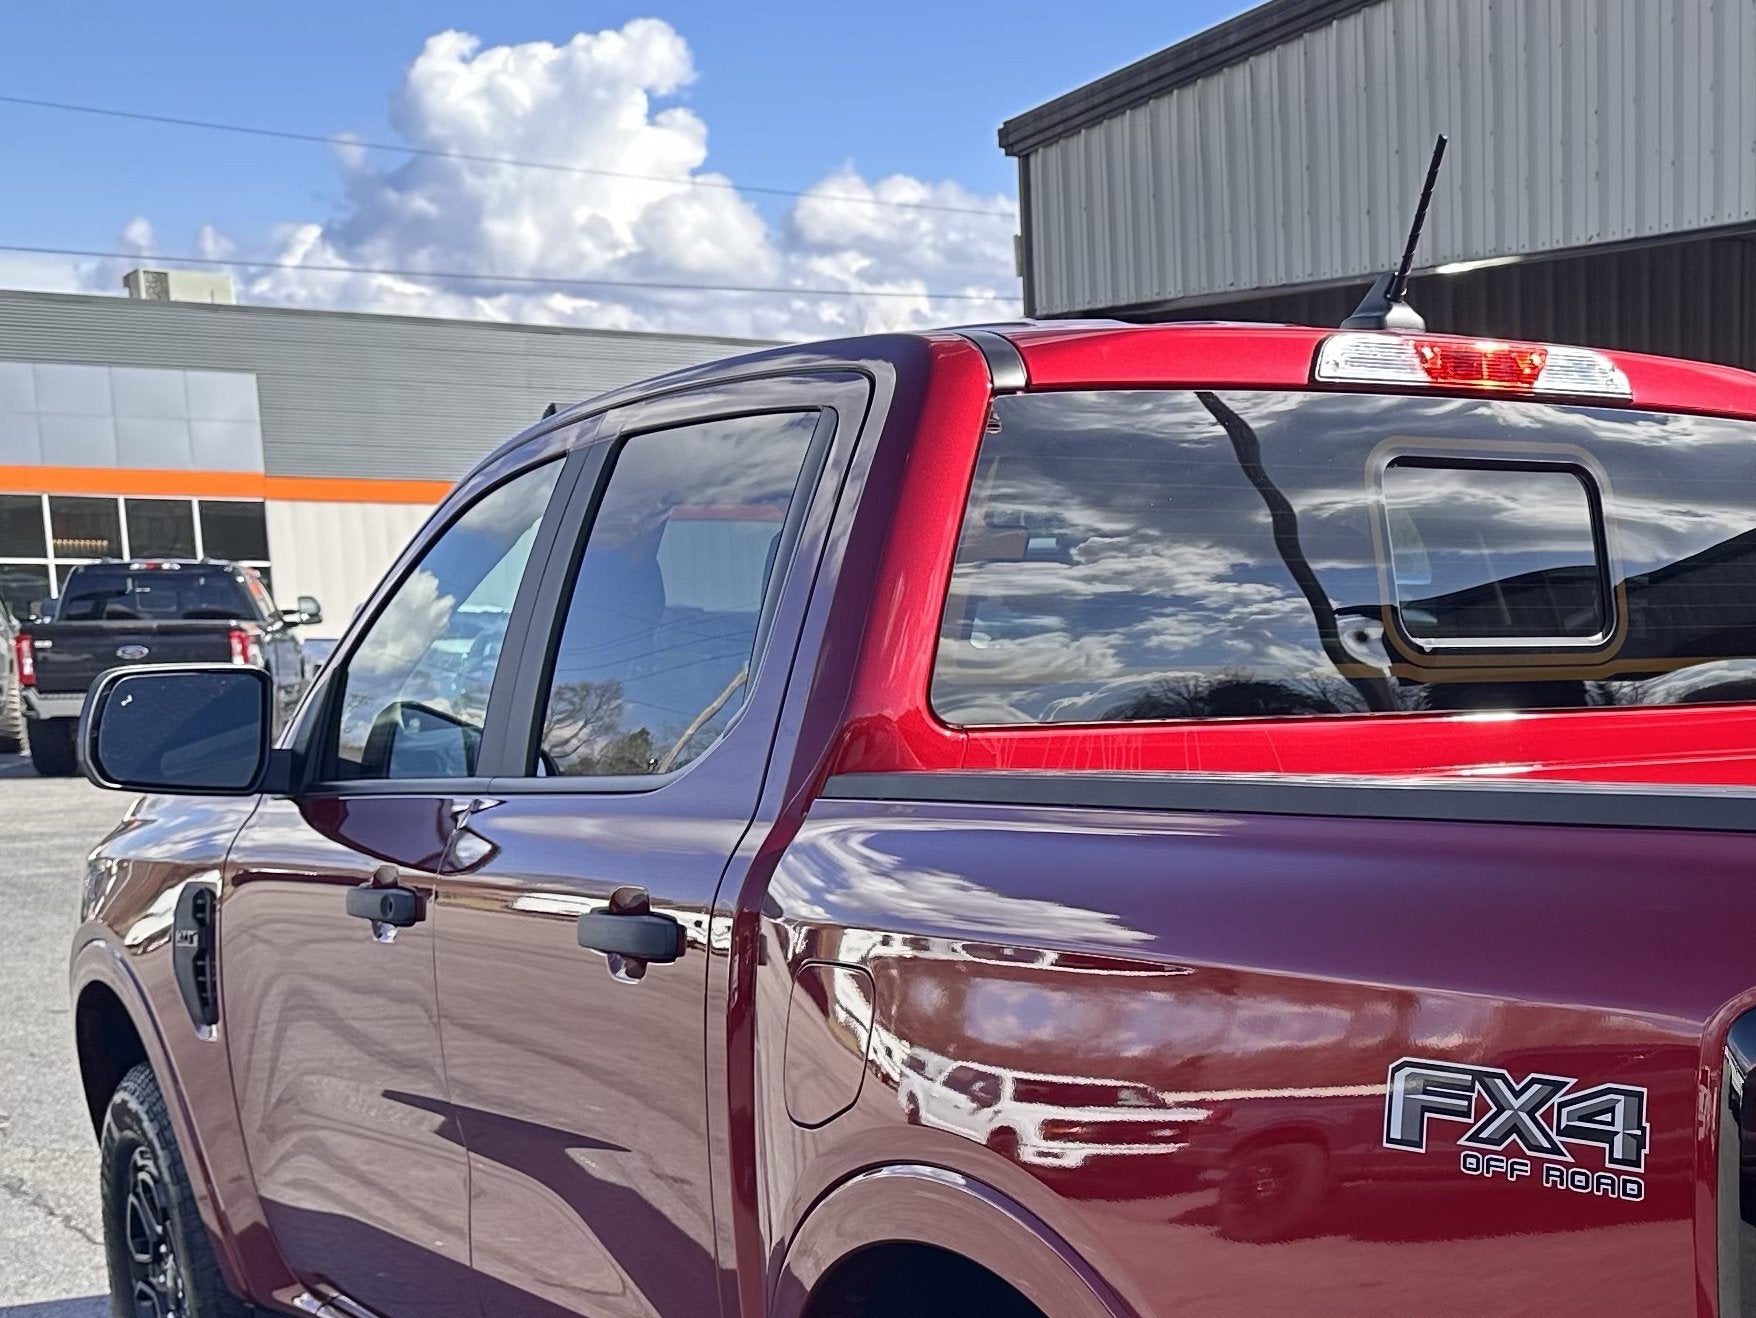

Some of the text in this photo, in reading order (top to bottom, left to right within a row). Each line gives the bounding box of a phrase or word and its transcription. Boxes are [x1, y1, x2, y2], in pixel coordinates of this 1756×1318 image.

[1383, 1056, 1650, 1173] FX4
[1460, 1150, 1645, 1201] OFF ROAD
